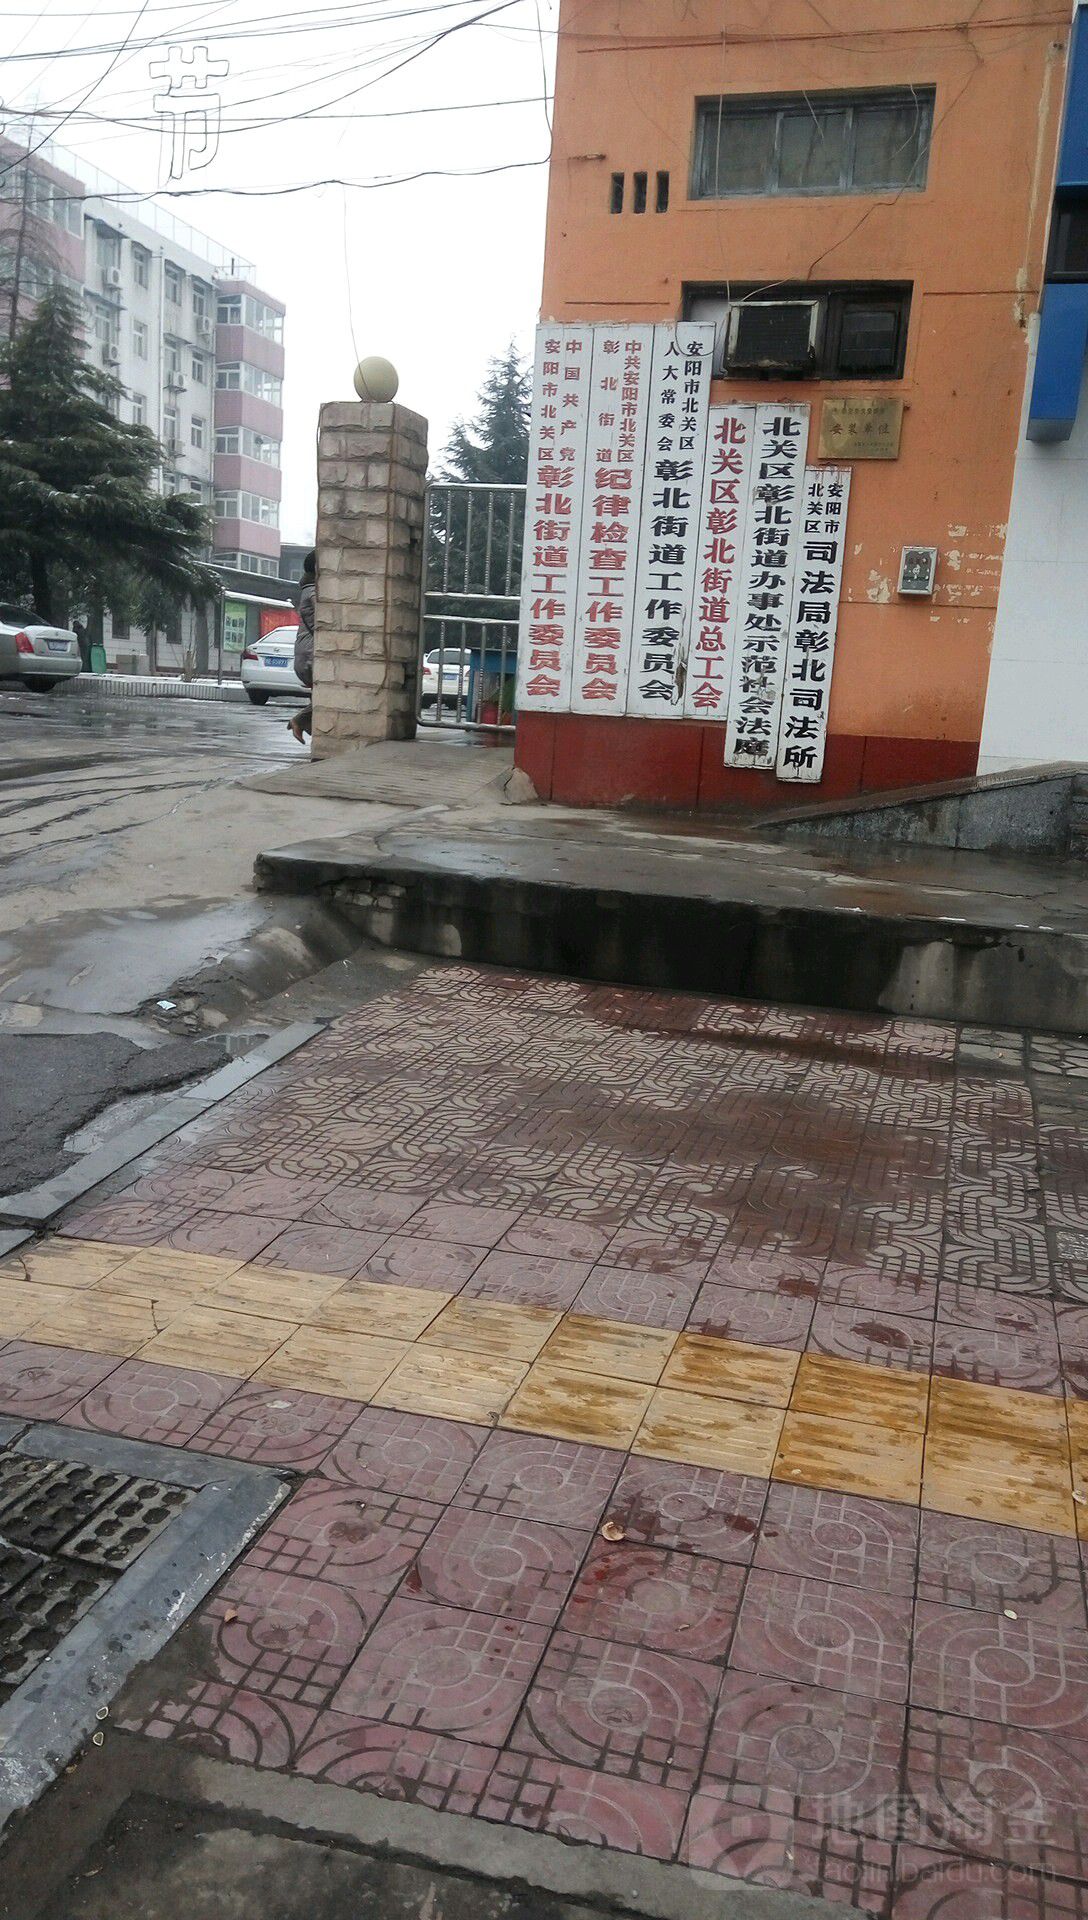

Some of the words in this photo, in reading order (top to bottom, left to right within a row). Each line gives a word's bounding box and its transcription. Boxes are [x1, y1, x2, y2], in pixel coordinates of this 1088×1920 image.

[538, 338, 561, 461] 安阳市北关区
[559, 339, 583, 462] 中国共产党
[597, 339, 620, 463] 彰北街道
[617, 339, 642, 463] 中共安阳市北关区
[657, 341, 680, 451] 人大常委会
[679, 340, 704, 450] 安阳市北关区
[691, 417, 746, 708] 北关区彰北街道总工会
[804, 483, 824, 534] 北关区
[824, 483, 843, 534] 安阳市
[526, 465, 576, 697] 彰北街道工作委员会
[582, 467, 633, 700] 纪律检查工作委员会
[638, 459, 694, 700] 彰北街道工作委员会
[783, 541, 838, 768] 司法局彰北司法所
